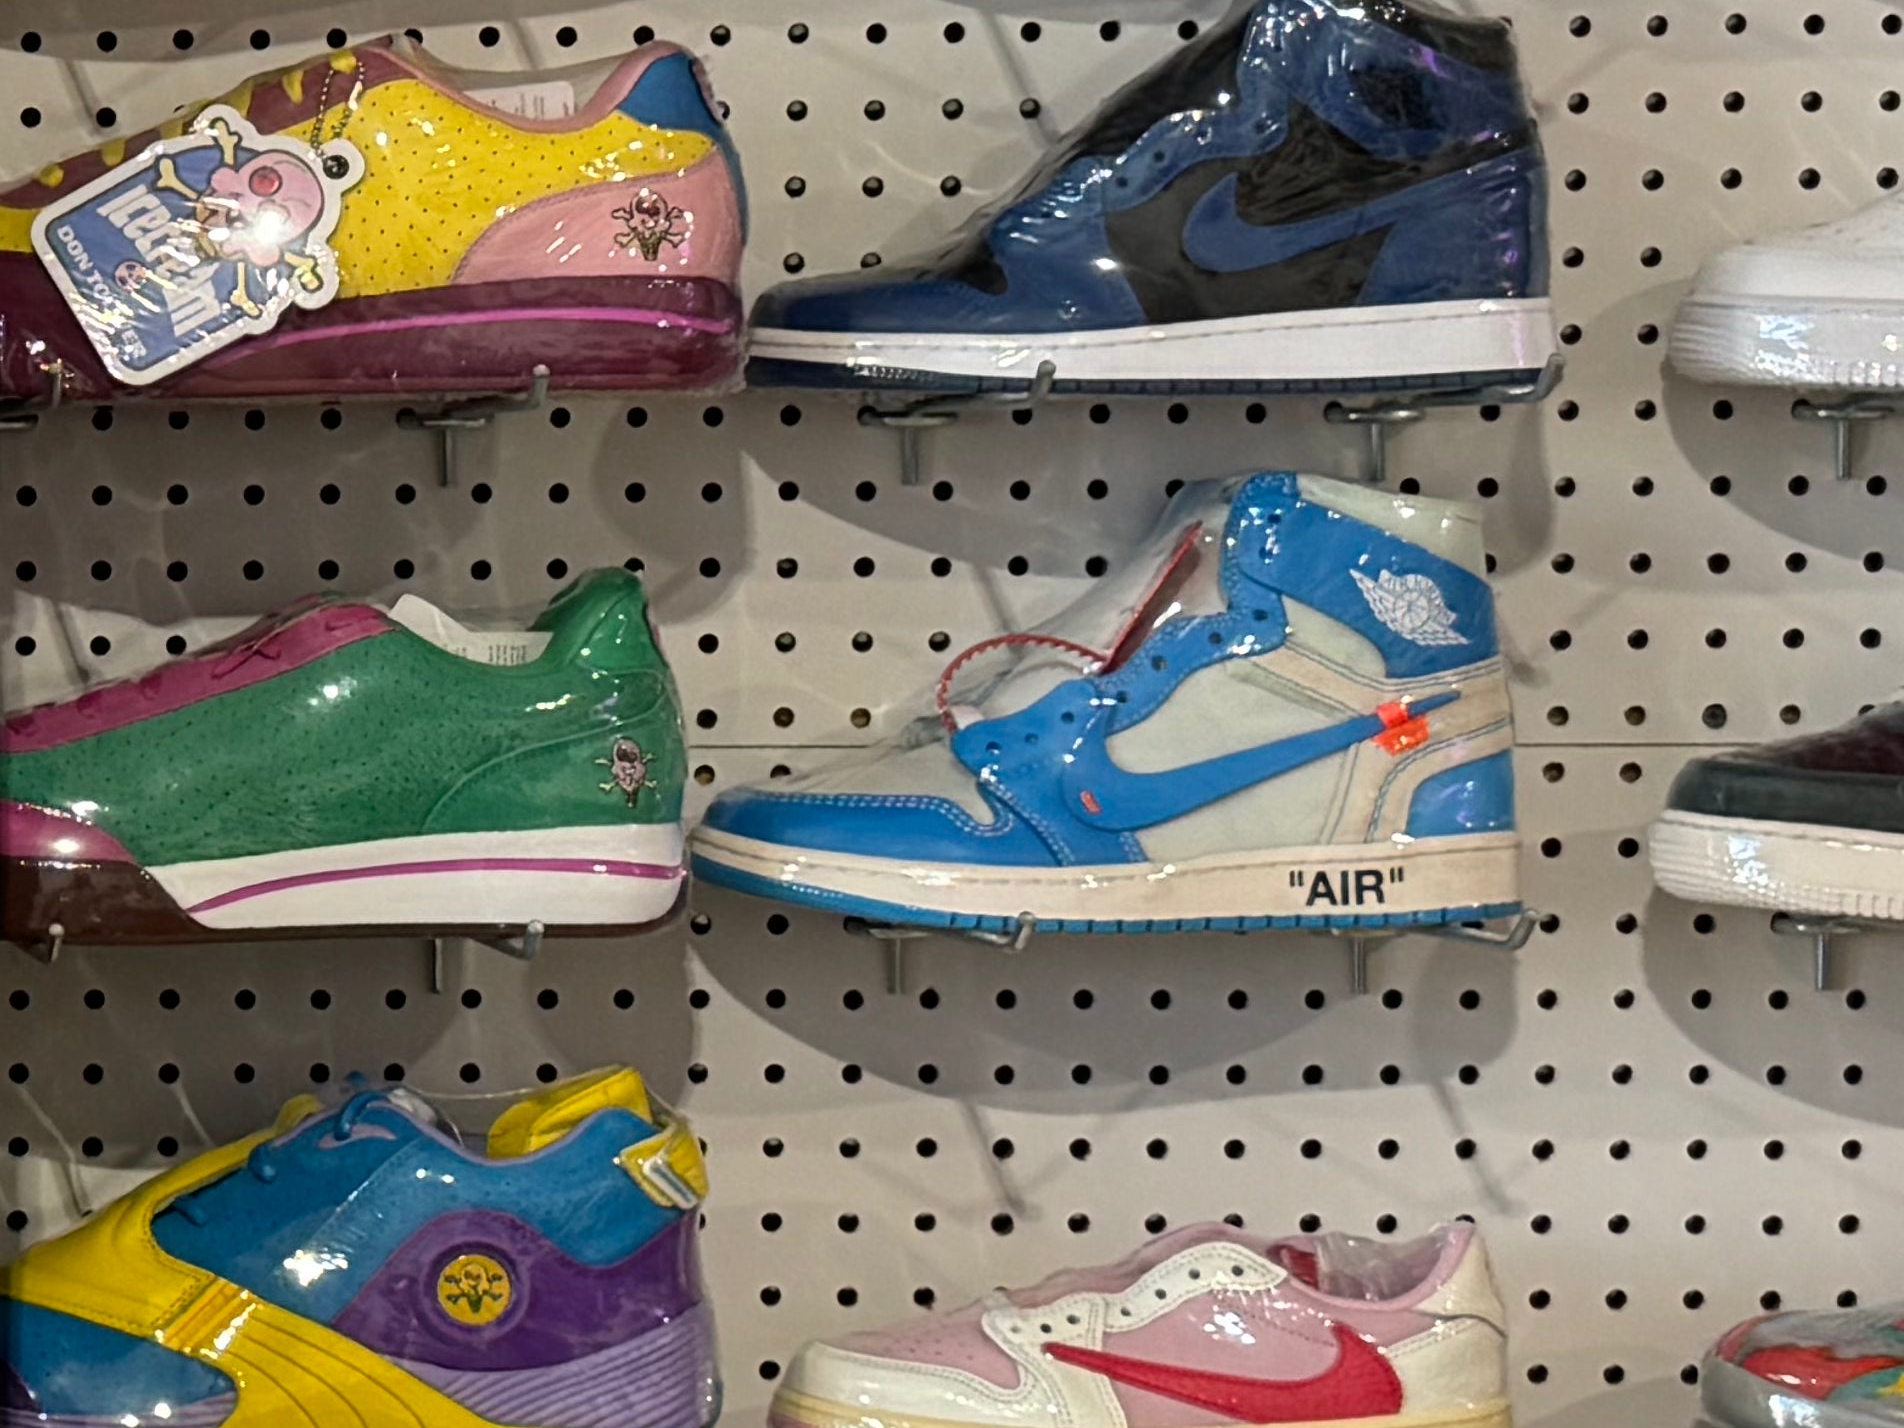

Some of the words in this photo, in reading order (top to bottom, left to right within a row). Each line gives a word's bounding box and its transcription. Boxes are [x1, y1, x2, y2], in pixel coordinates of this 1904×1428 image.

[56, 224, 93, 272] DON
[86, 272, 148, 359] TOER
[1289, 866, 1404, 907] "AIR"
